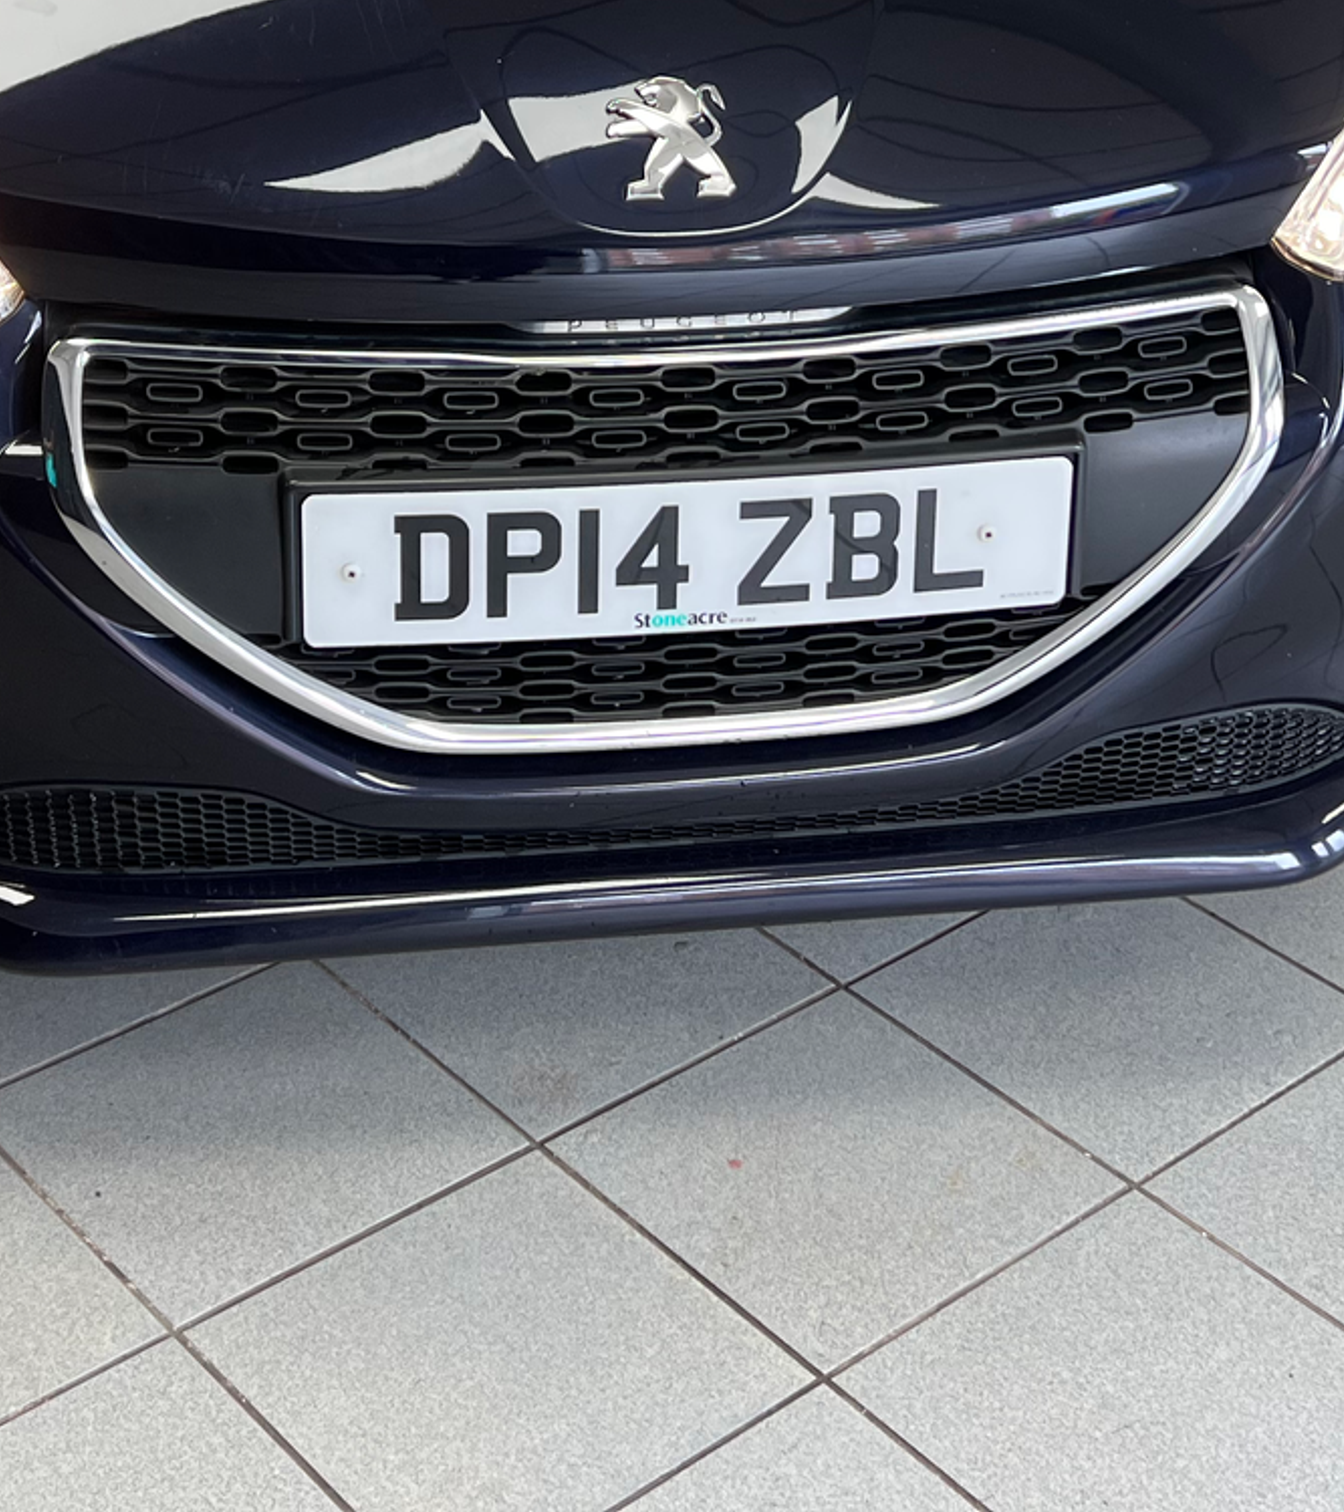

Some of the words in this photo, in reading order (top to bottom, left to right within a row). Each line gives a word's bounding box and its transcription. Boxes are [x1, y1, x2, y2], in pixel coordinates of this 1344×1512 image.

[394, 505, 690, 622] DP14
[737, 488, 985, 607] ZBL
[634, 611, 728, 629] Stoneacre
